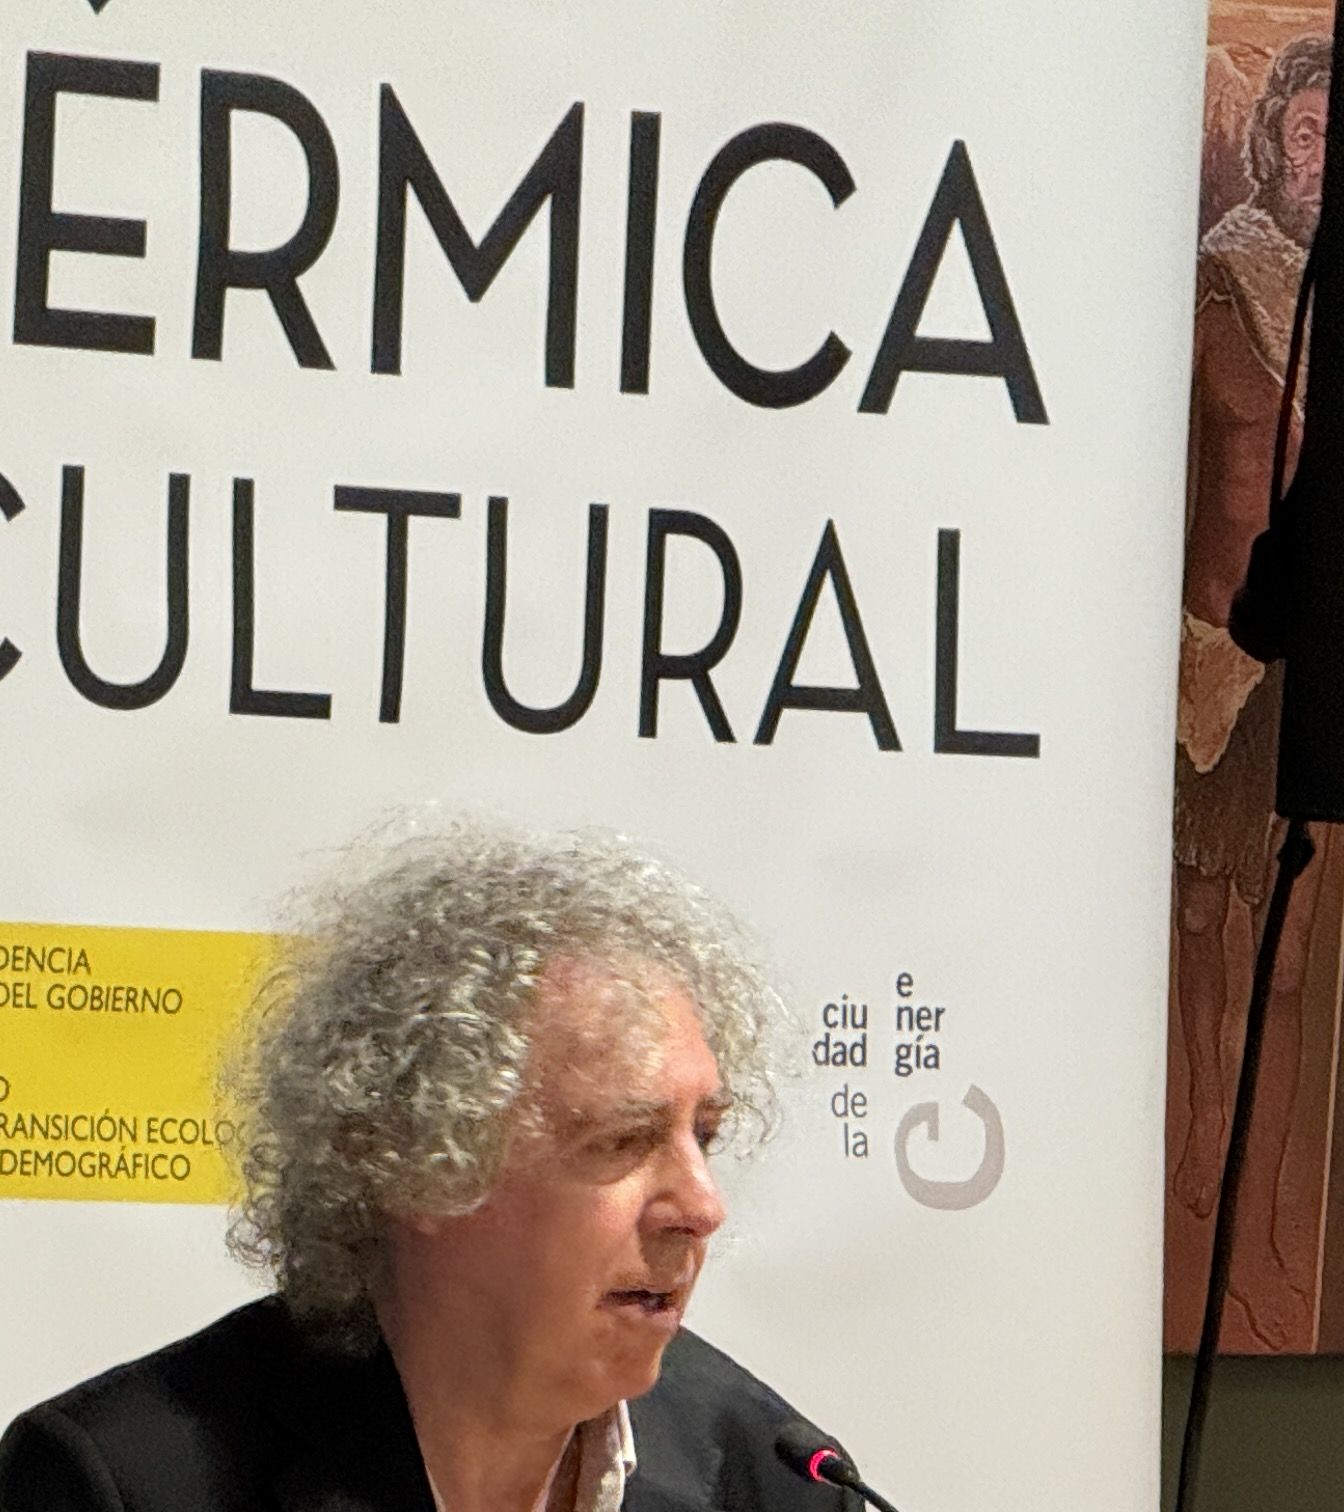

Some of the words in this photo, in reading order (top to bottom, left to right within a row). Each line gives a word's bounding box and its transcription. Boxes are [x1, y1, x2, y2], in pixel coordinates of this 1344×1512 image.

[47, 983, 183, 1015] GOBIERNO
[896, 971, 914, 998] e
[822, 993, 868, 1030] ciu
[896, 1004, 946, 1033] ner
[811, 1032, 868, 1068] dad
[894, 1033, 941, 1078] gía
[831, 1082, 868, 1119] de
[844, 1122, 869, 1159] la
